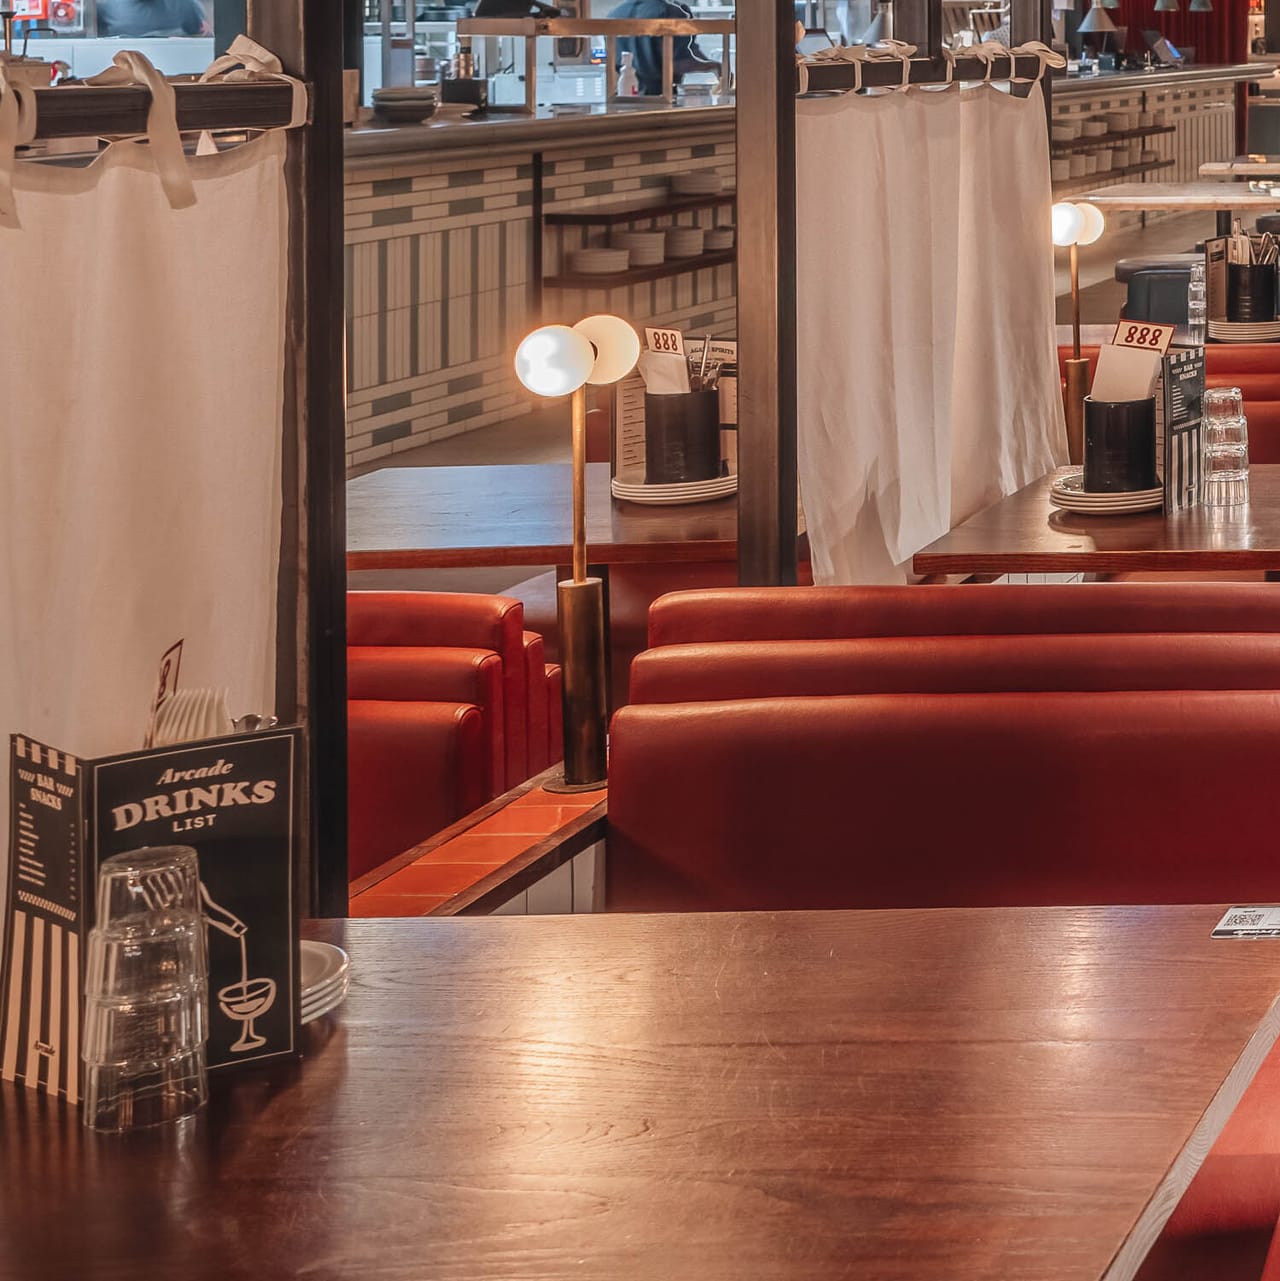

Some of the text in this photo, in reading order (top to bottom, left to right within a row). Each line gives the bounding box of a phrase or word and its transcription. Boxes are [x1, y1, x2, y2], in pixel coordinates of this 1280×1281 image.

[653, 331, 678, 352] 888
[1125, 325, 1163, 347] 888
[36, 773, 55, 791] BAR
[155, 759, 234, 786] Arcade
[30, 787, 63, 811] SNACKS
[111, 779, 278, 832] DRINKS
[172, 814, 217, 833] LIST
